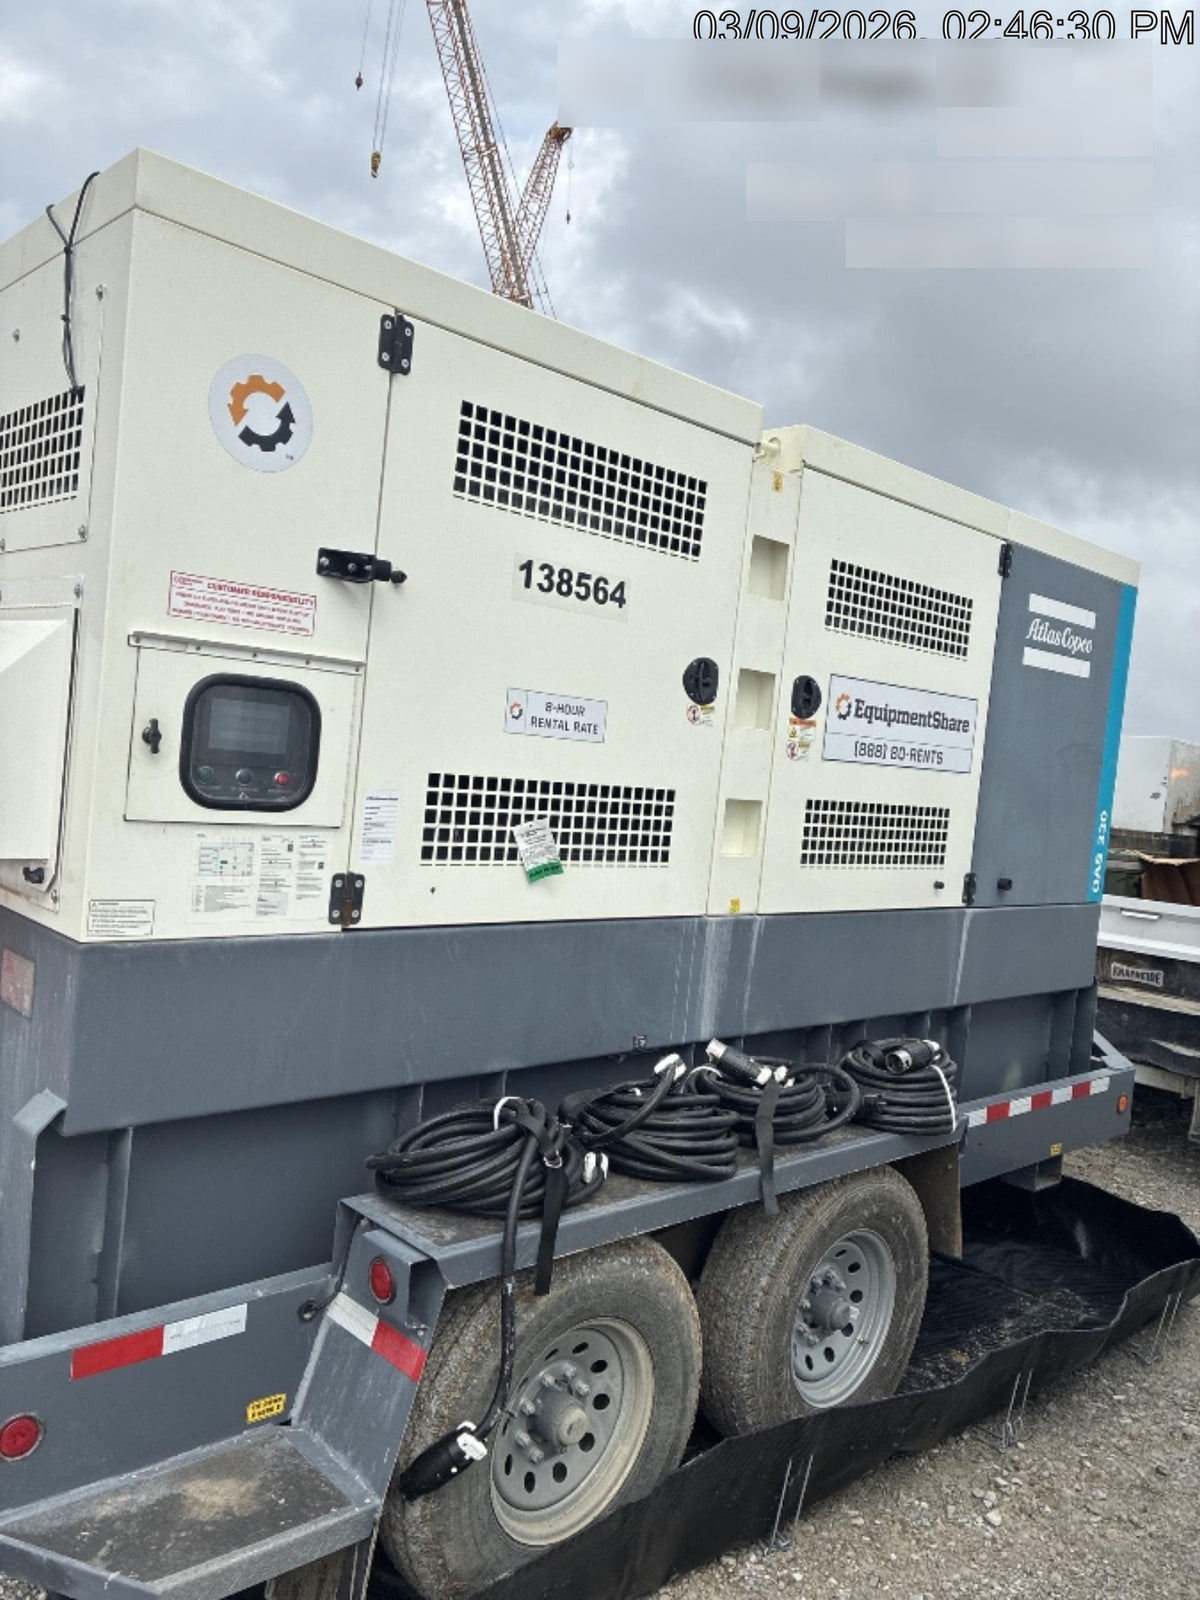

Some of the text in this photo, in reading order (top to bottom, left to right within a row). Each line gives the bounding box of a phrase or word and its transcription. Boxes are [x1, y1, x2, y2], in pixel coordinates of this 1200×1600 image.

[519, 559, 627, 609] 138564
[545, 701, 586, 717] 8-HOUR
[853, 698, 971, 734] EquipmentShare
[530, 716, 599, 735] RENTAL RATE
[854, 740, 888, 760] (888)
